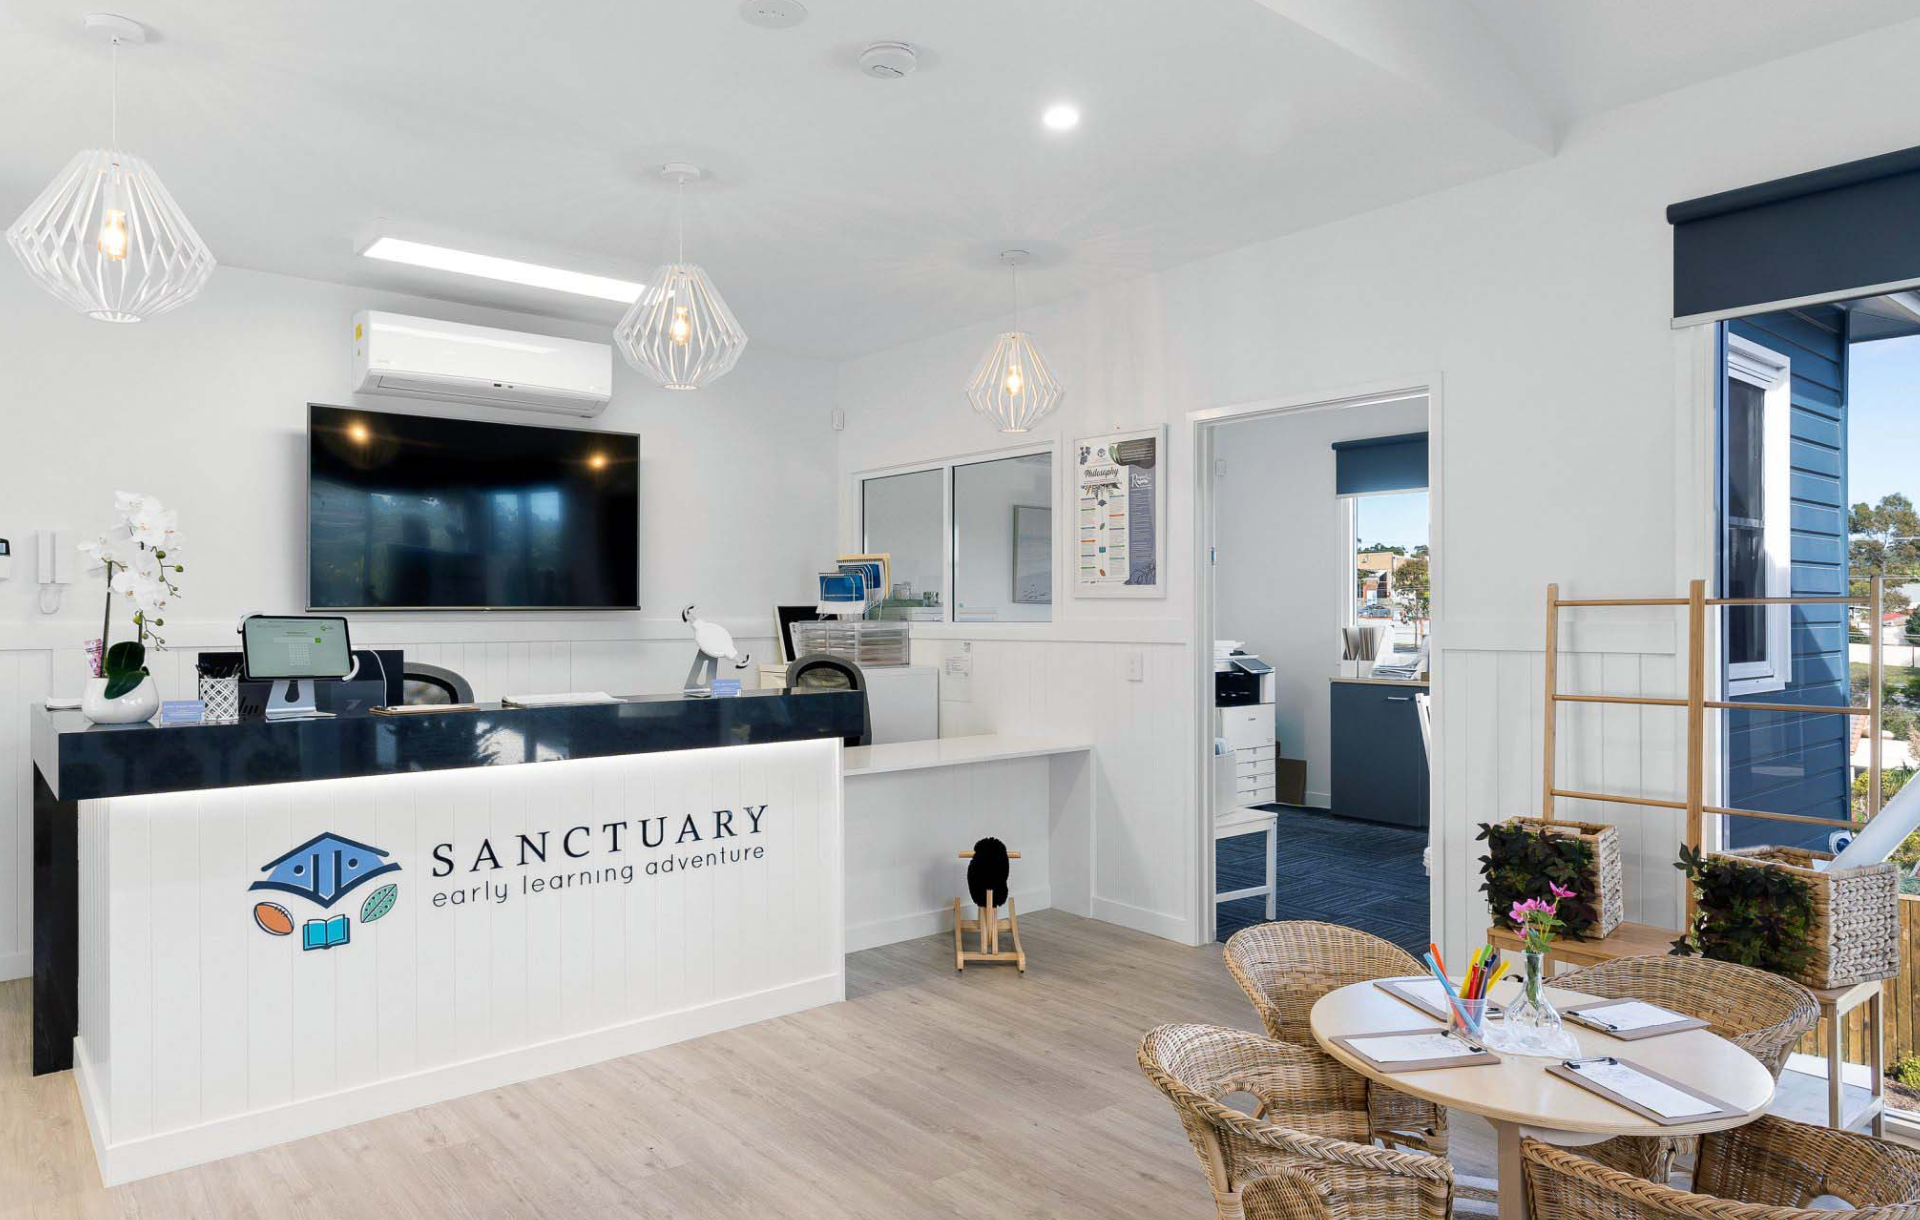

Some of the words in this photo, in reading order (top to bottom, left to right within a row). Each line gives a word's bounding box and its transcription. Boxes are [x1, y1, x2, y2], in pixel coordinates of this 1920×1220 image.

[1084, 466, 1118, 478] Philosophy
[432, 804, 768, 878] SANCTUARY
[432, 880, 508, 908] early
[522, 865, 634, 895] learning
[645, 845, 764, 876] adventure
